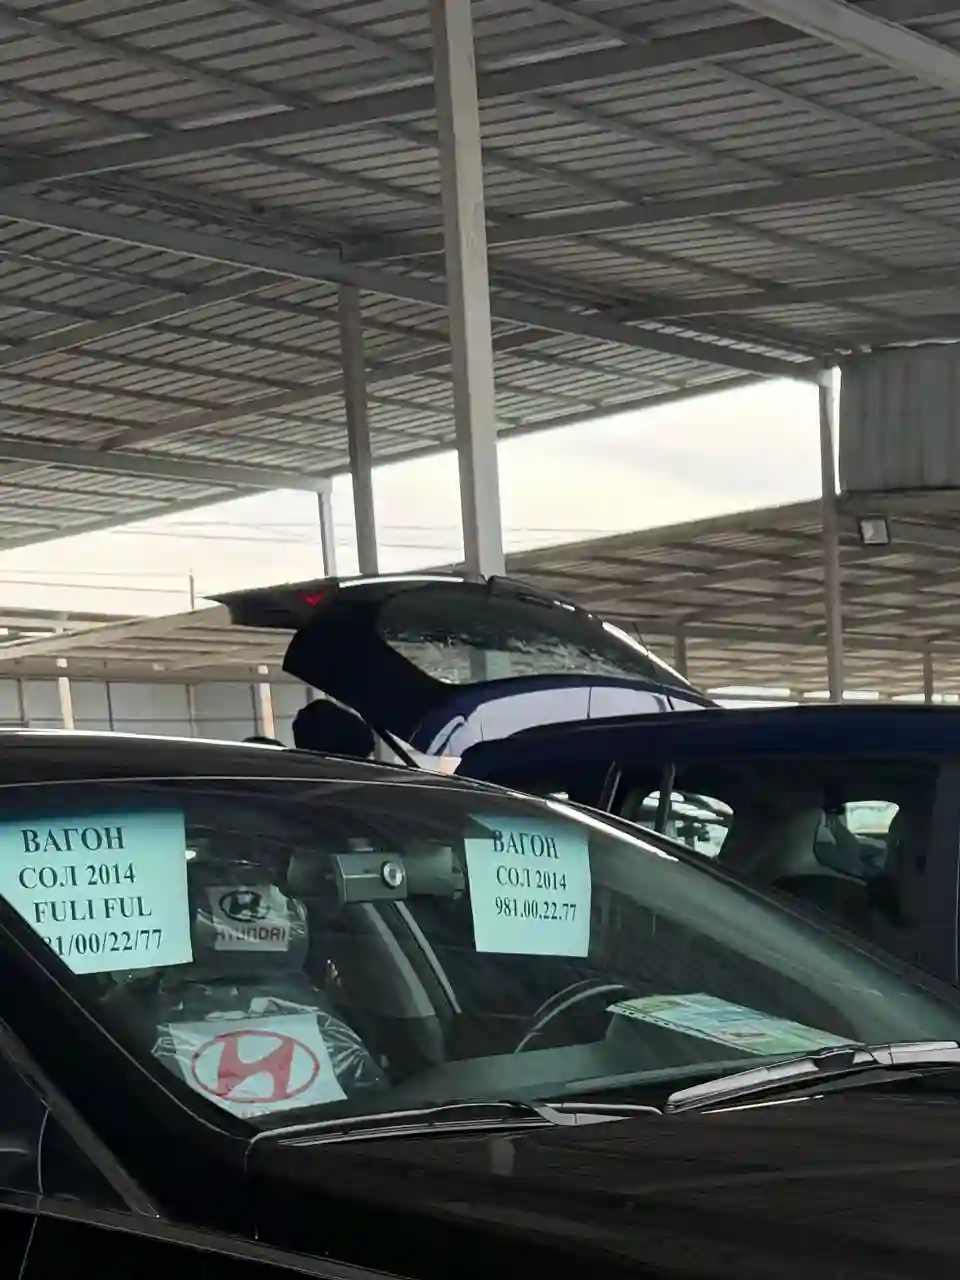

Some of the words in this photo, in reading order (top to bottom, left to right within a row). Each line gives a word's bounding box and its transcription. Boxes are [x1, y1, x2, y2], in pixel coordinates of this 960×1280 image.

[21, 827, 125, 853] ВАГОН
[18, 865, 78, 889] СОЛ
[87, 862, 136, 886] 2014
[496, 865, 533, 887] СОЛ
[535, 870, 567, 890] 2014
[104, 896, 152, 919] FUL
